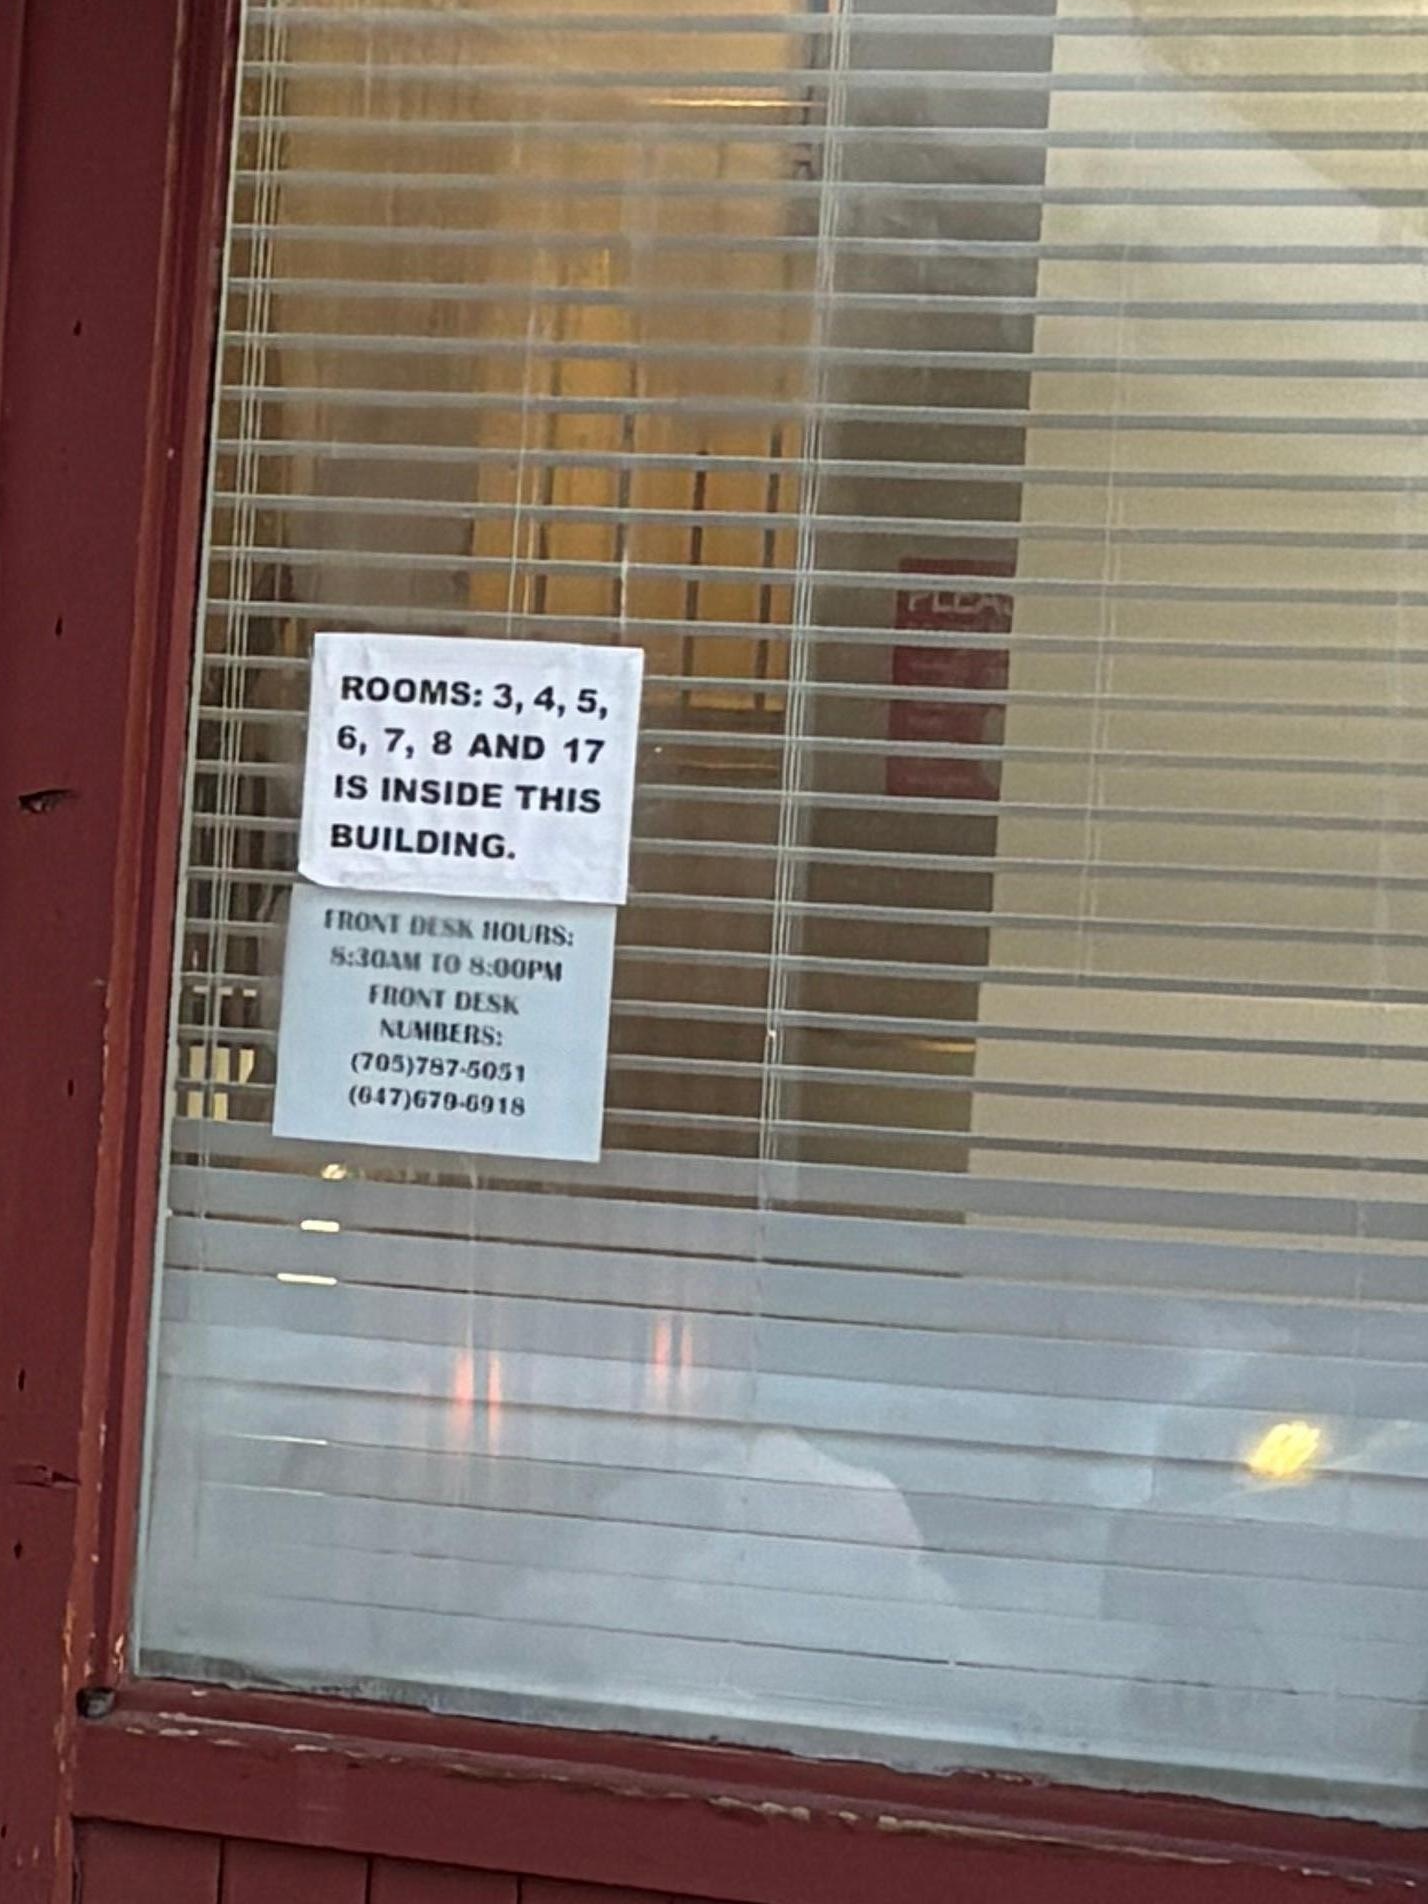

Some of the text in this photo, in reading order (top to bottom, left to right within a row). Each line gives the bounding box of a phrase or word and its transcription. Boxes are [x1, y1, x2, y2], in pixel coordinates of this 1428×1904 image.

[340, 675, 609, 720] ROOMS: 3, 4, 5,
[337, 725, 606, 764] 6, 7, 8 AND 17
[334, 774, 602, 814] IS INSIDE THIS
[330, 823, 517, 860] BUILDING.
[324, 908, 575, 948] FRONT DESK HOURS:
[330, 945, 563, 983] 8:30AM TO 8:00PM
[369, 983, 520, 1016] FRONT DESK
[379, 1018, 504, 1047] NUMBERS:
[350, 1051, 527, 1083] (705)787-5051
